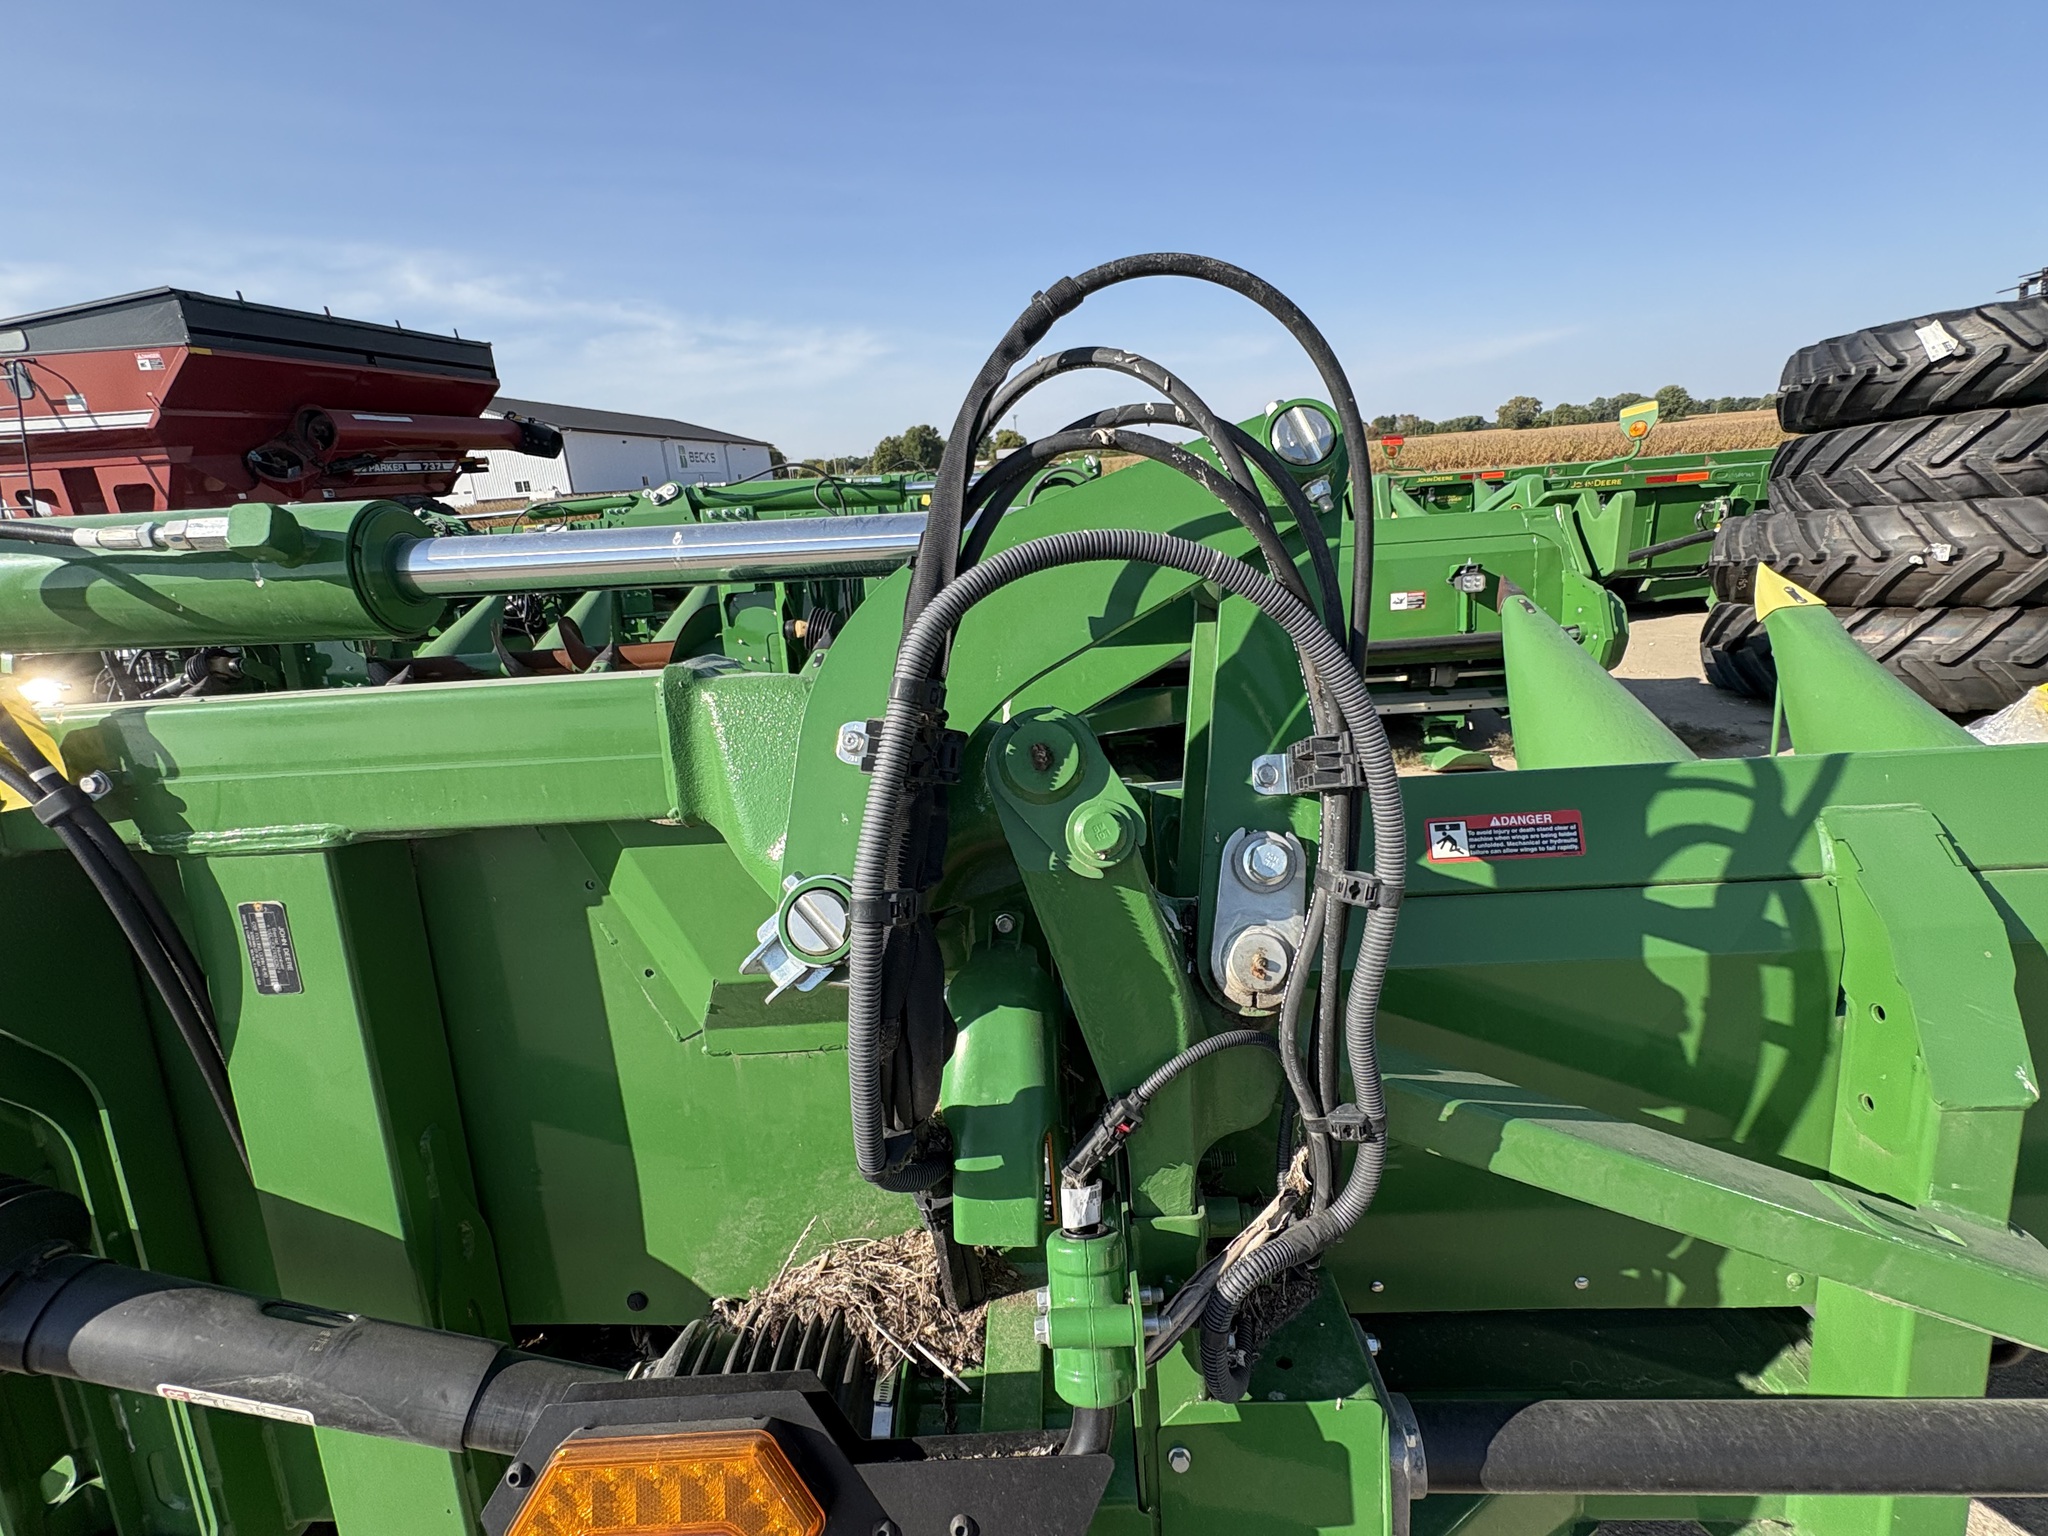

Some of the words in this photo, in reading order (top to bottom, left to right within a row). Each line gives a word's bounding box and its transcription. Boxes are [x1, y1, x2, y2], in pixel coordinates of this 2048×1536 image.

[369, 463, 404, 472] PARKER
[423, 462, 441, 470] 737
[1594, 478, 1622, 486] DEERE
[1500, 814, 1552, 826] DANGER
[278, 926, 287, 945] JOHN
[282, 947, 293, 971] DEERE
